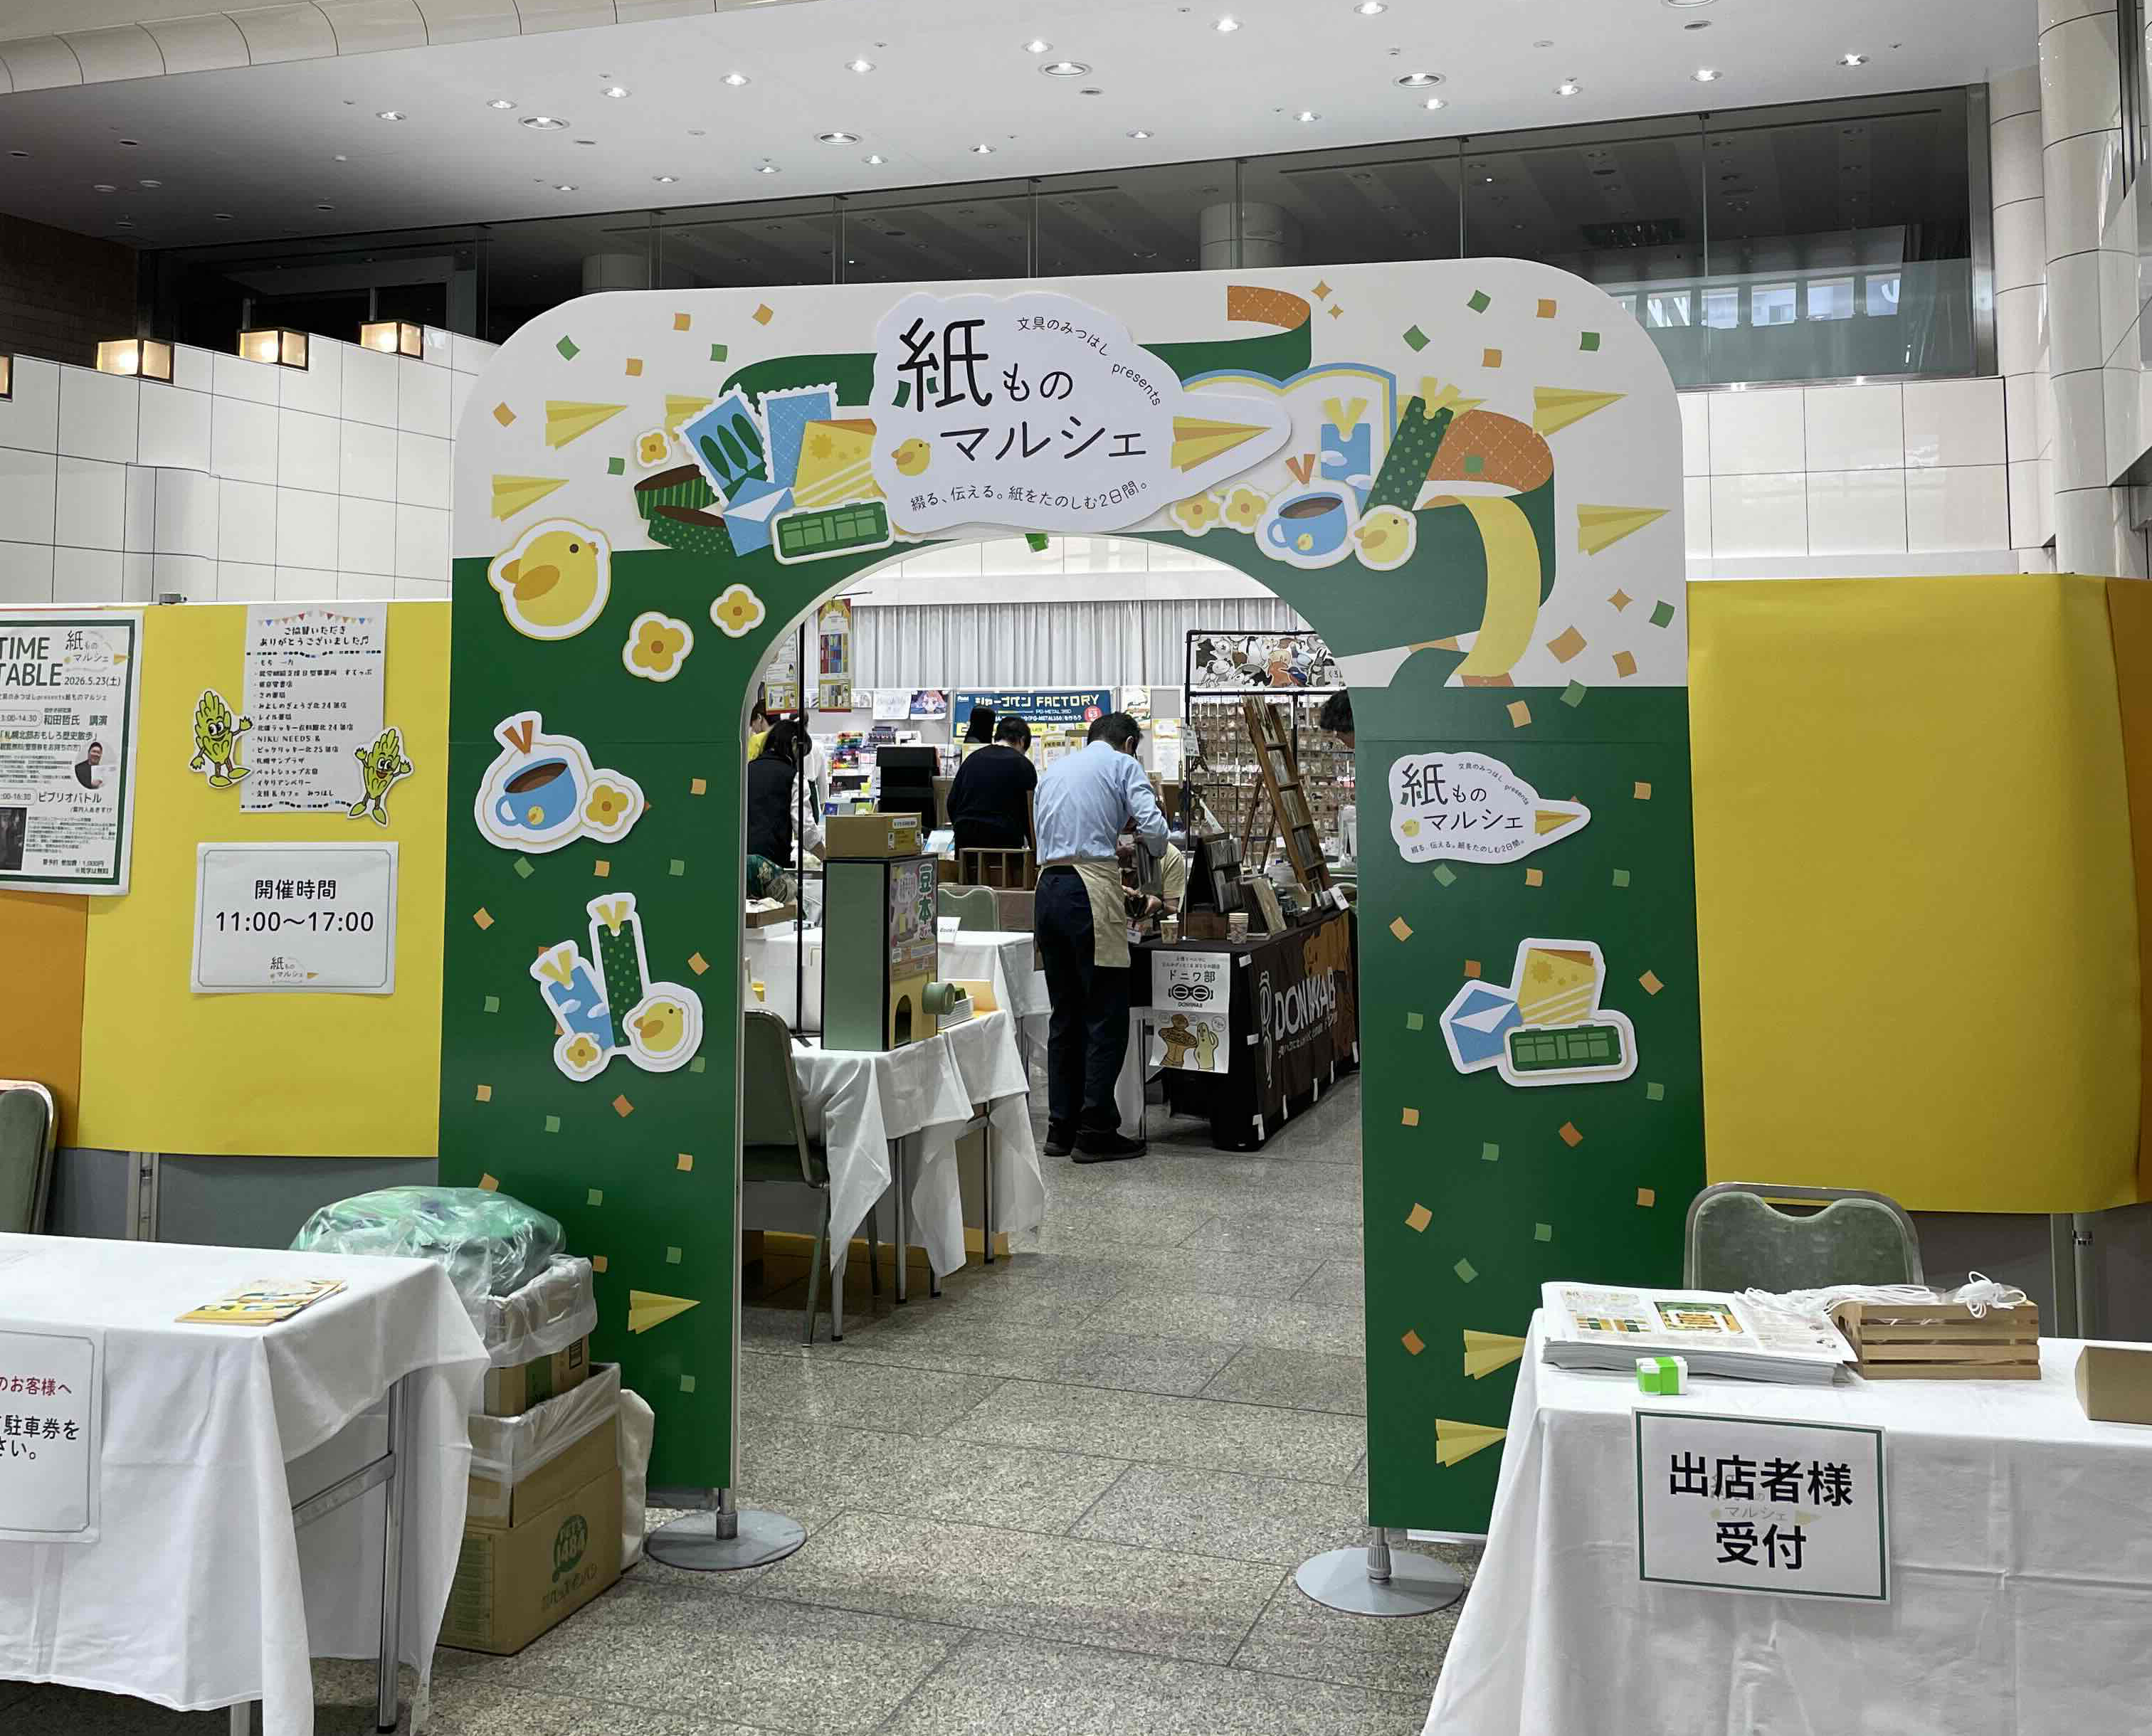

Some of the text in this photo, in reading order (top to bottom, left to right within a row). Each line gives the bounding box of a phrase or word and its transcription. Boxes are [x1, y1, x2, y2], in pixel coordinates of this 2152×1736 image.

[892, 318, 1073, 412] 紙もの
[1018, 317, 1161, 406] 文具のみつはし presents
[940, 416, 1147, 462] マルシェ
[64, 677, 121, 687] 2026.5.23(土)
[1036, 694, 1099, 707] FACTORY
[1401, 763, 1487, 808] 紙もの
[38, 793, 102, 804] ビブリオバトル
[1423, 809, 1524, 831] マルシェ
[255, 879, 337, 899] 開催時間
[216, 912, 374, 931] 11:00～17:00
[1169, 969, 1216, 983] ドニワ部
[0, 1414, 80, 1440] 駐車券を
[1670, 1451, 1853, 1506] 出店者様
[1716, 1521, 1807, 1570] 受付
